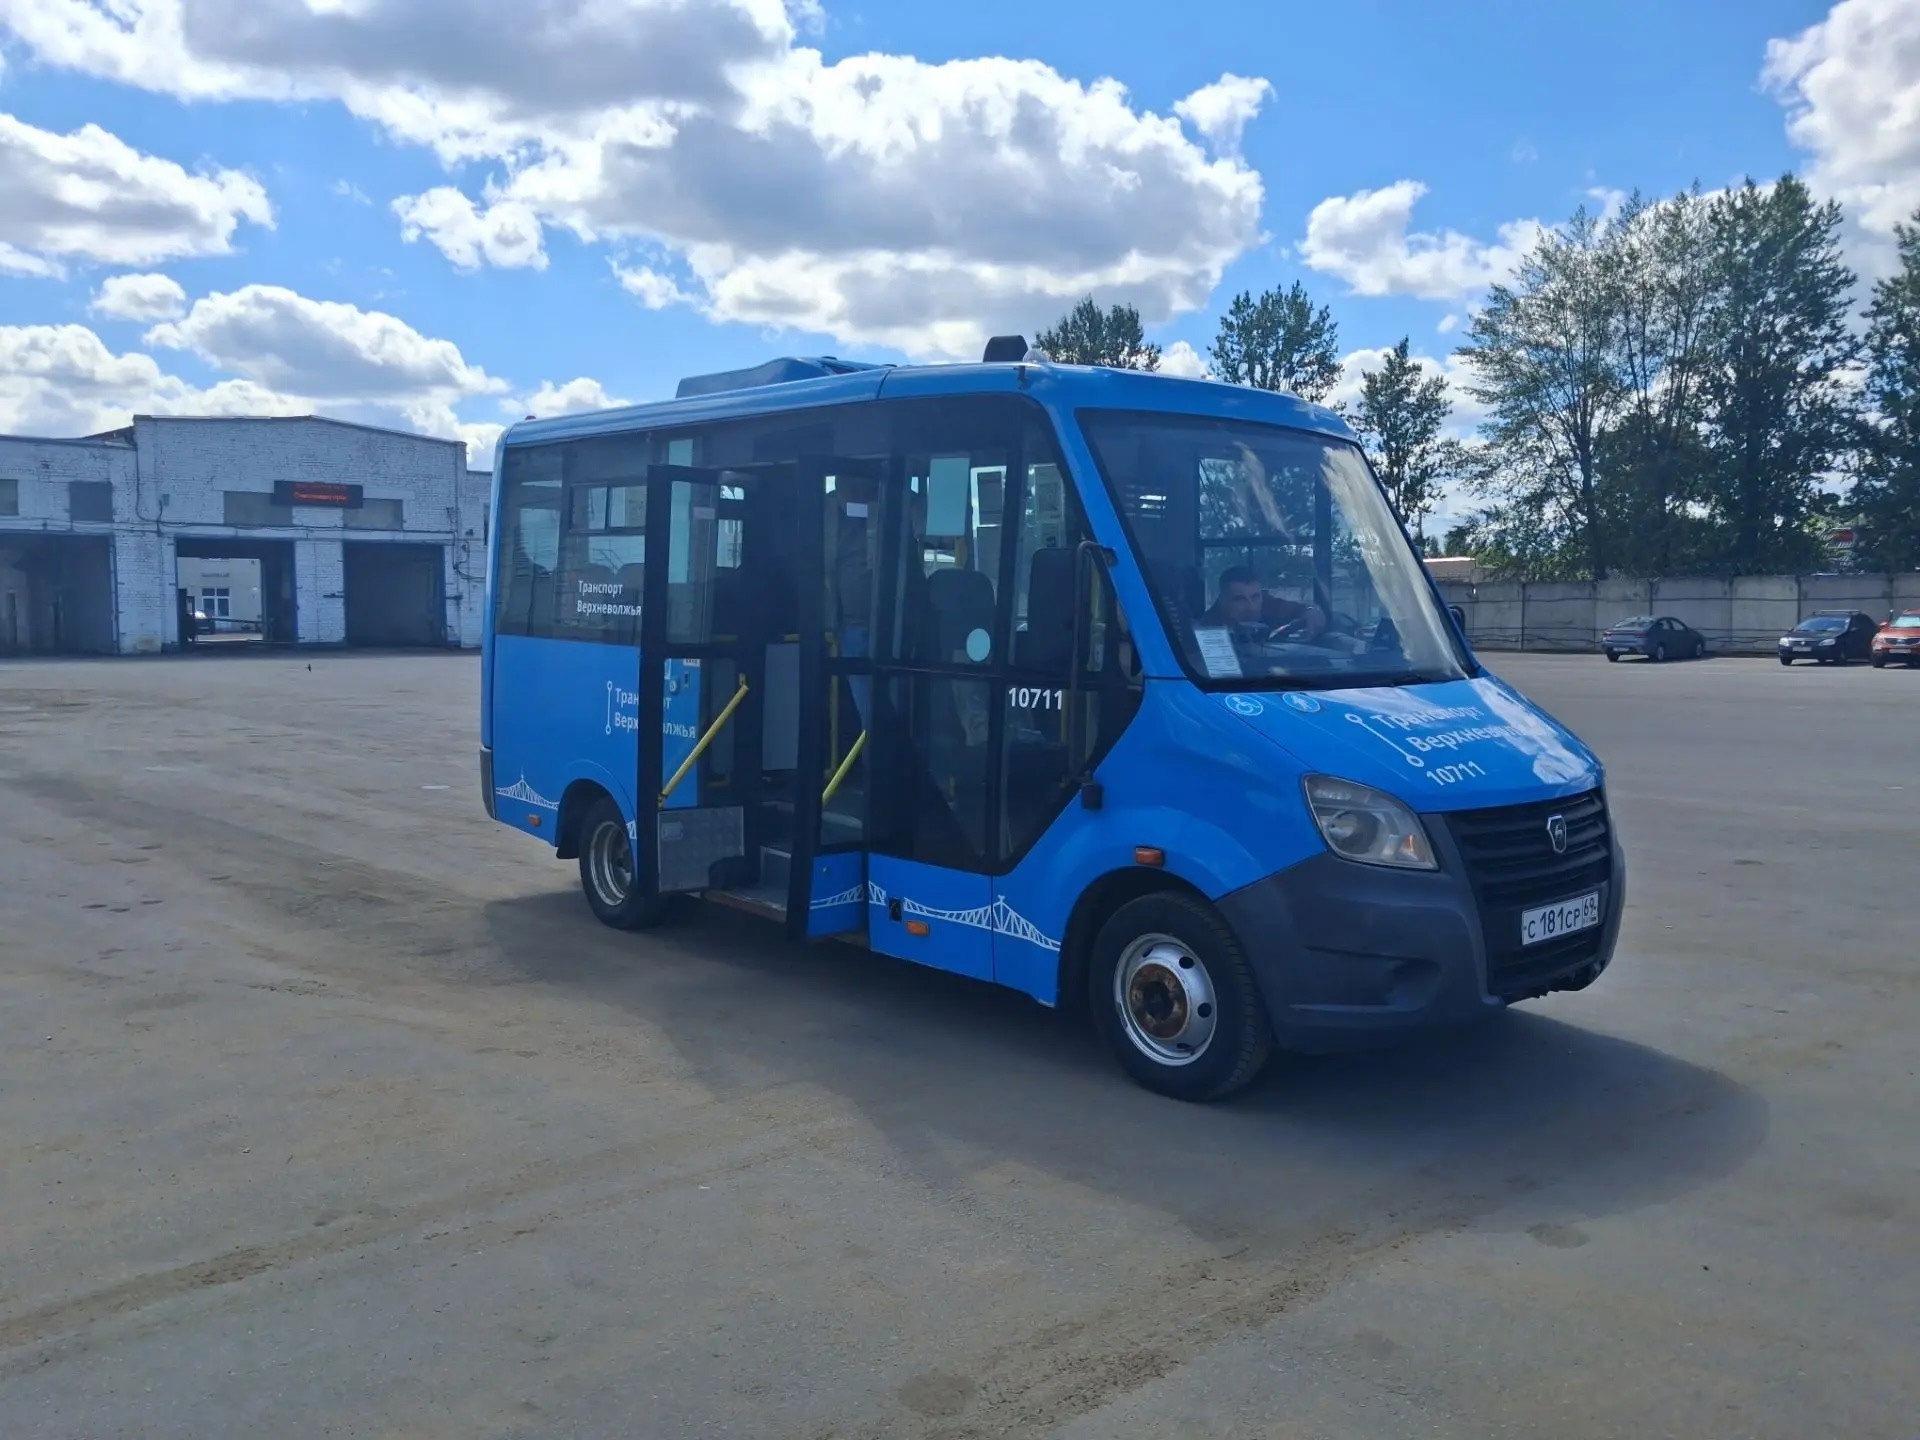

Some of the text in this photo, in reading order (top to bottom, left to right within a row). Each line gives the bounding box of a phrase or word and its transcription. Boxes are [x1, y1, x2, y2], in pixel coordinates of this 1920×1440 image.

[578, 580, 623, 598] Транспорт
[577, 600, 642, 616] Верхневолжья
[1008, 687, 1063, 710] 10711
[1370, 706, 1484, 731] Транспорт
[1426, 760, 1487, 787] 10711
